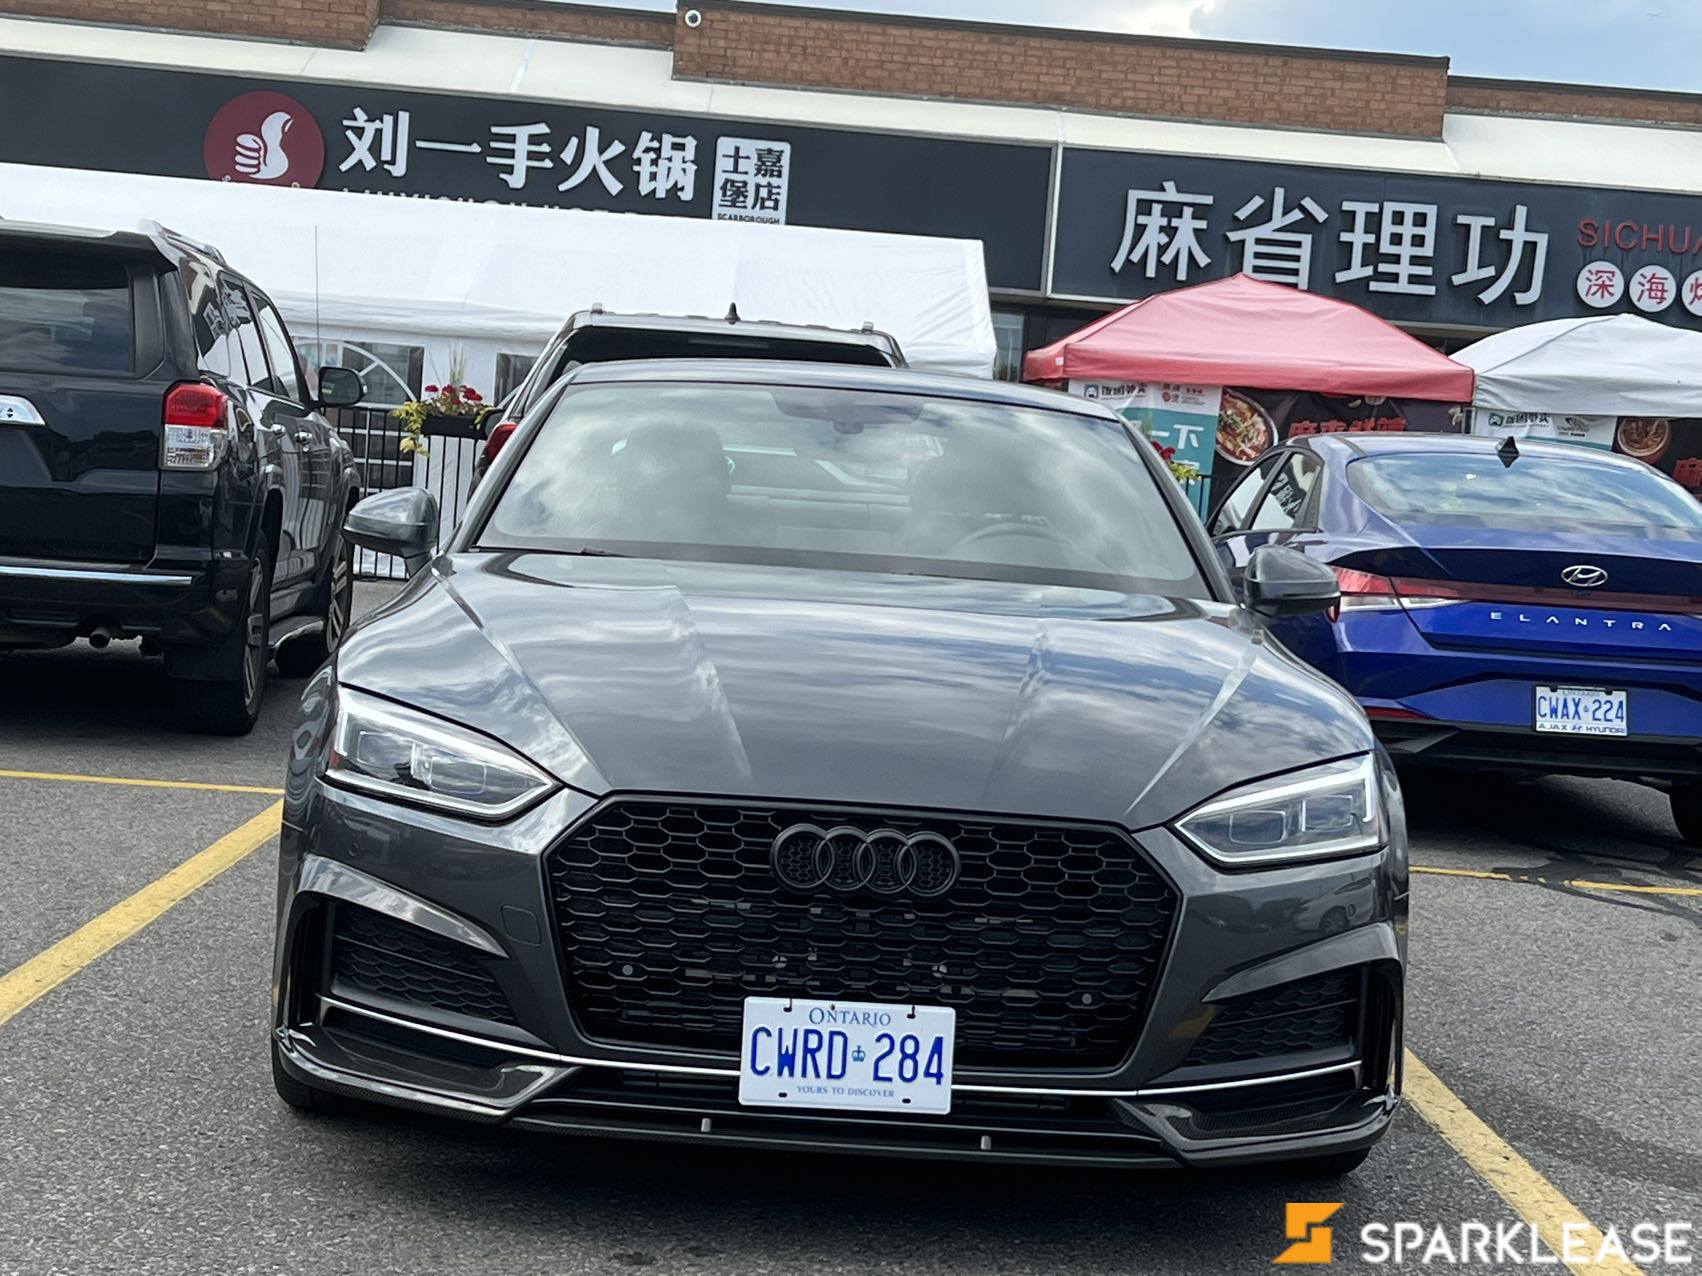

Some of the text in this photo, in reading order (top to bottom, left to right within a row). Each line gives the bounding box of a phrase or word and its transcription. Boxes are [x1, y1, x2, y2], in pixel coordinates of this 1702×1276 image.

[338, 107, 698, 201] 刘一手火锅
[718, 177, 782, 211] 堡店
[1110, 181, 1549, 305] 麻省理功
[1490, 611, 1672, 632] ELANTRA
[1537, 696, 1625, 723] CWAX 224
[1538, 723, 1626, 734] AJAX HYUNDAI
[809, 1007, 892, 1028] ONTARIO
[750, 1026, 944, 1086] CWRD 284
[797, 1085, 895, 1098] YOURS TO DISCOVER
